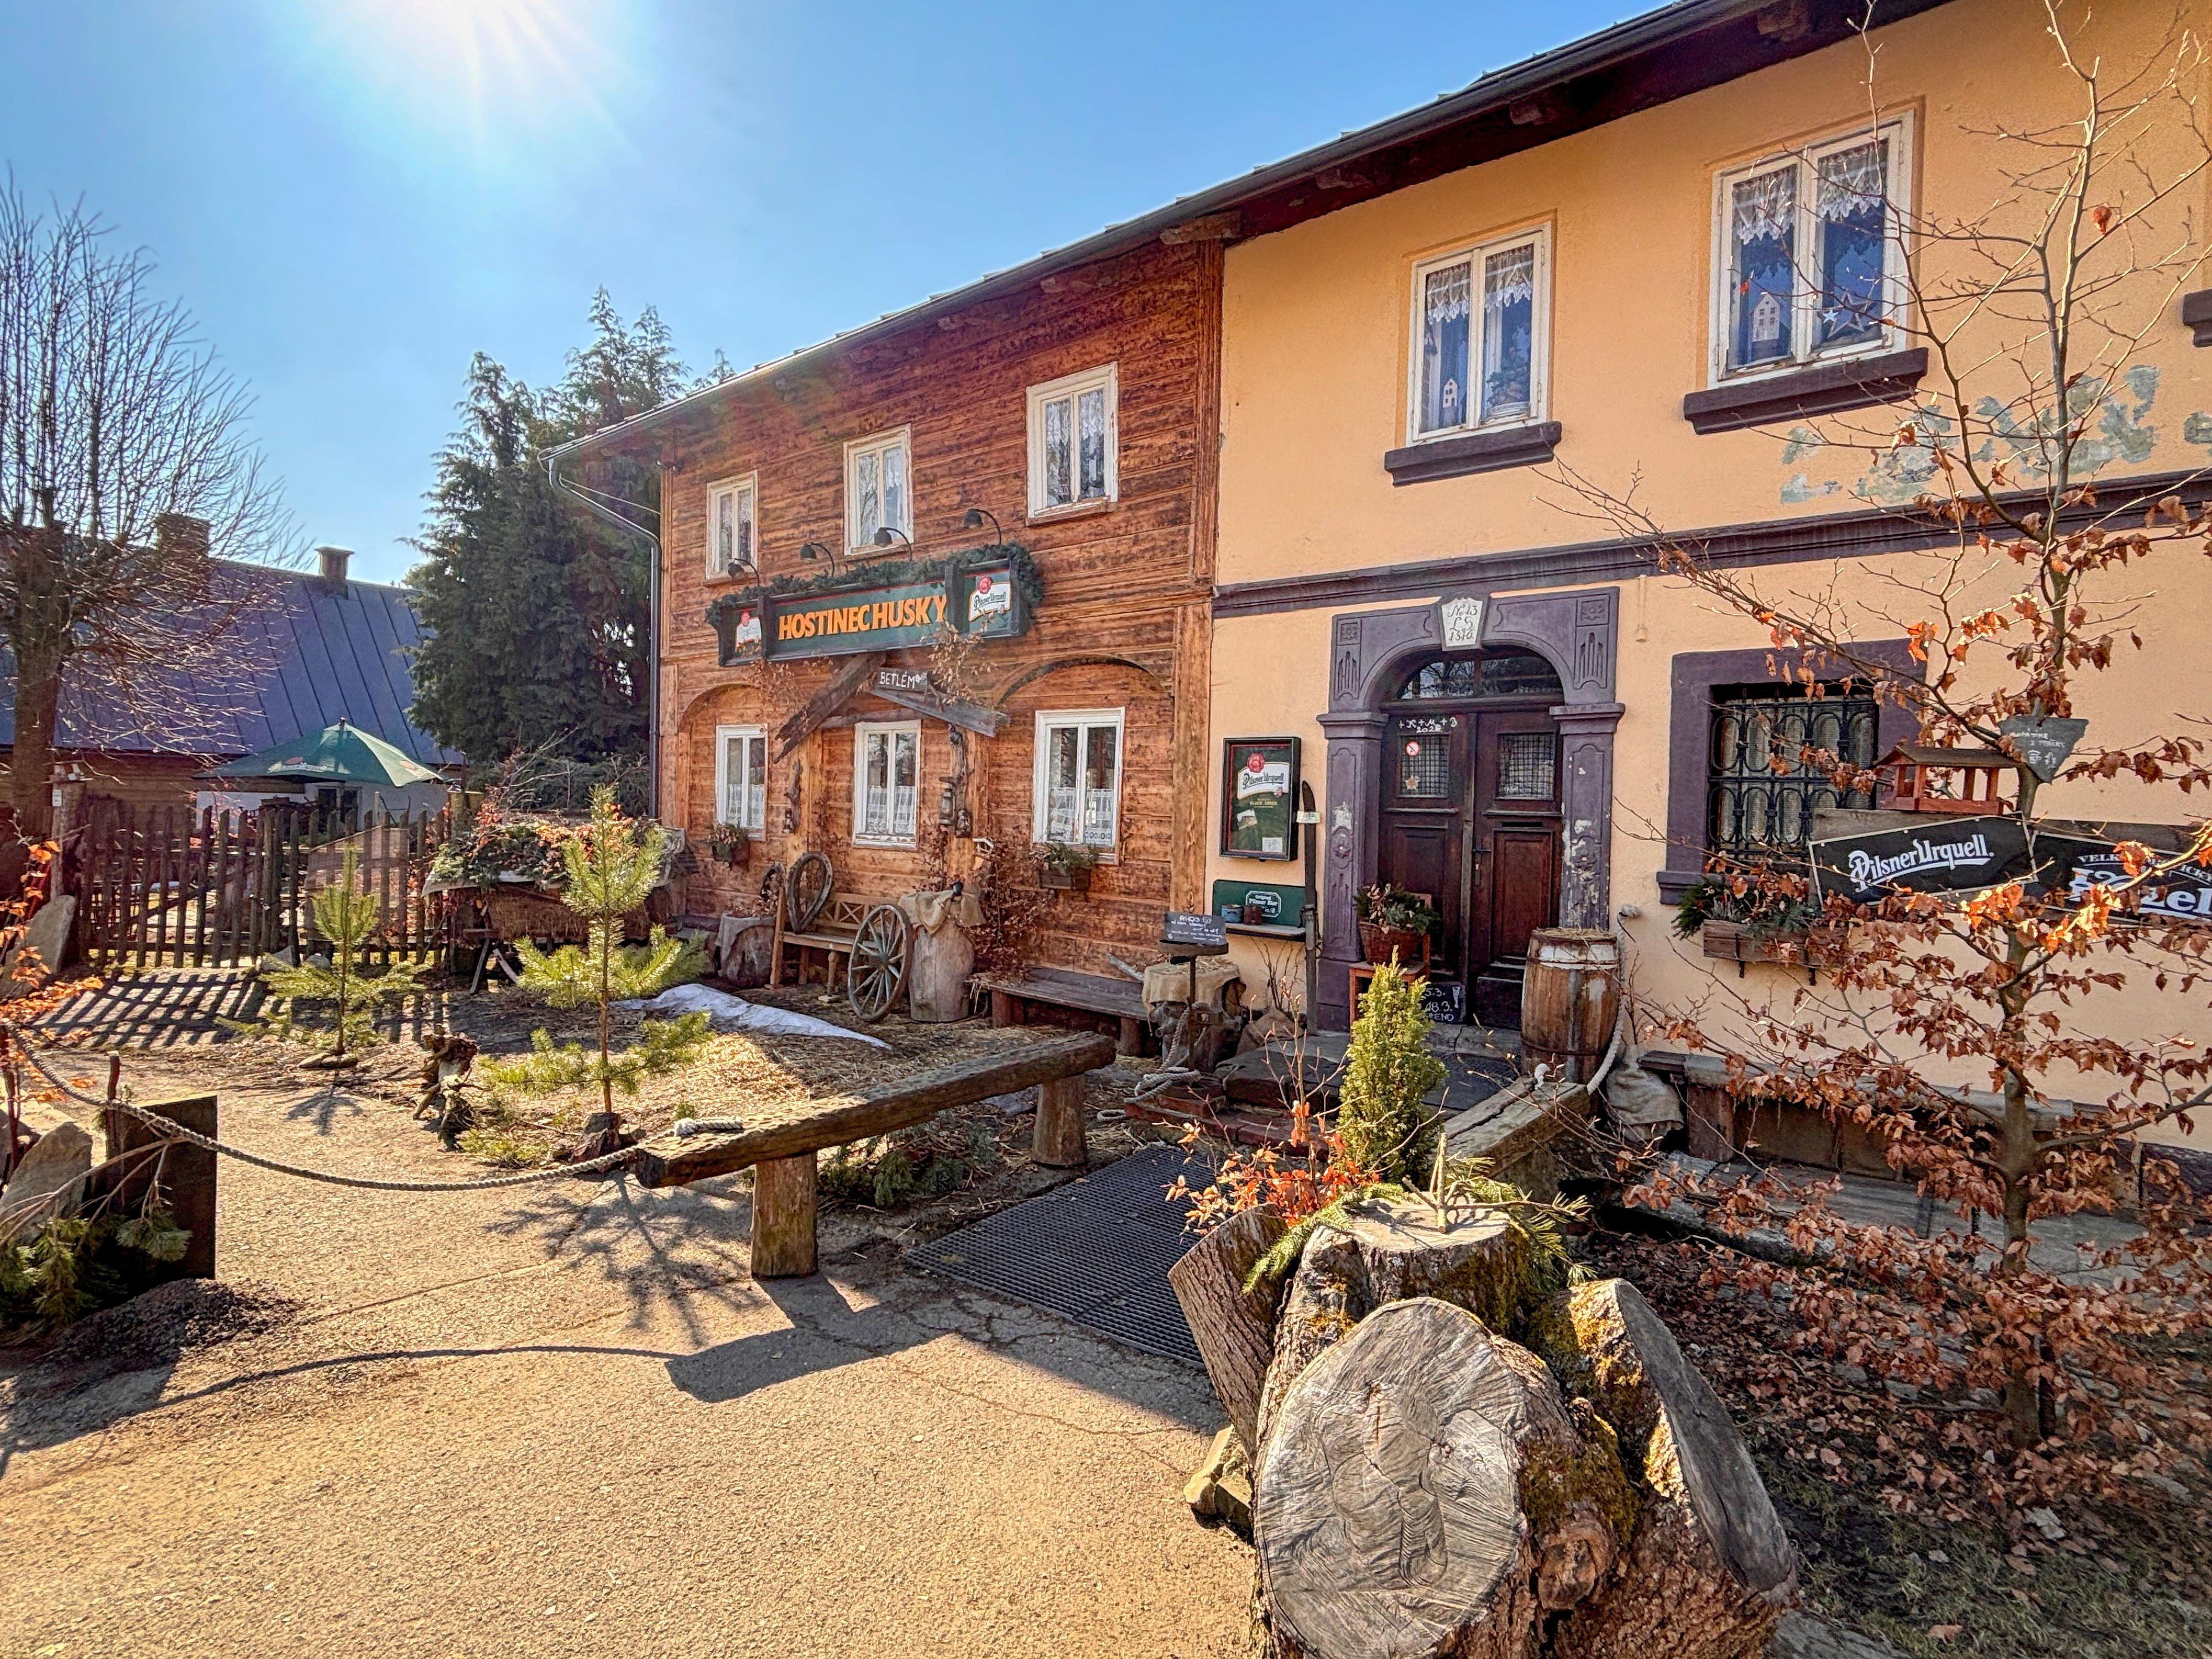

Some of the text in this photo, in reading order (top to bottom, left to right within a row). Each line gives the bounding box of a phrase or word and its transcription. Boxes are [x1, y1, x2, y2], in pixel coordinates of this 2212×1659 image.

[778, 594, 947, 640] HOSTINEC HUSKY
[879, 670, 915, 689] BETLÉM
[1848, 834, 1989, 893] Pilsner Urquell
[2068, 867, 2212, 916] Kzel
